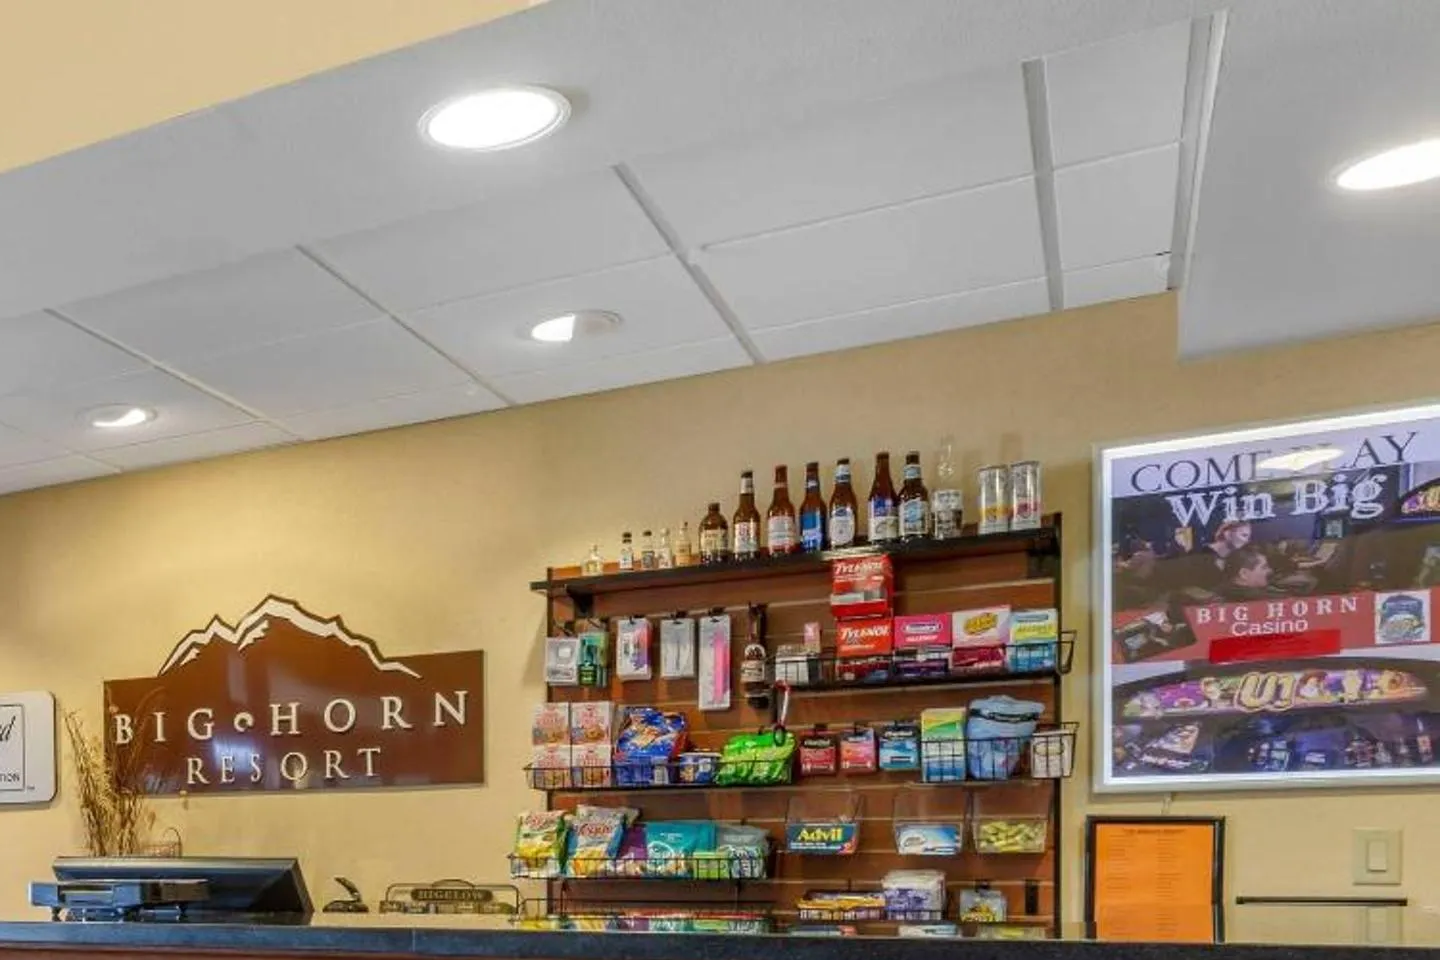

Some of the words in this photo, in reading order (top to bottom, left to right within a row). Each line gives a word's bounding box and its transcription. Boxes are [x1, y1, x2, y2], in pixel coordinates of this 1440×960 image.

[1165, 486, 1275, 526] Win
[1291, 473, 1387, 519] Big
[1196, 605, 1250, 625] BIG
[1267, 597, 1359, 619] HORN
[1231, 618, 1308, 637] Casino
[115, 708, 215, 745] BIG
[269, 690, 469, 737] HORN
[186, 747, 381, 785] RESORT
[798, 828, 842, 841] Advil
